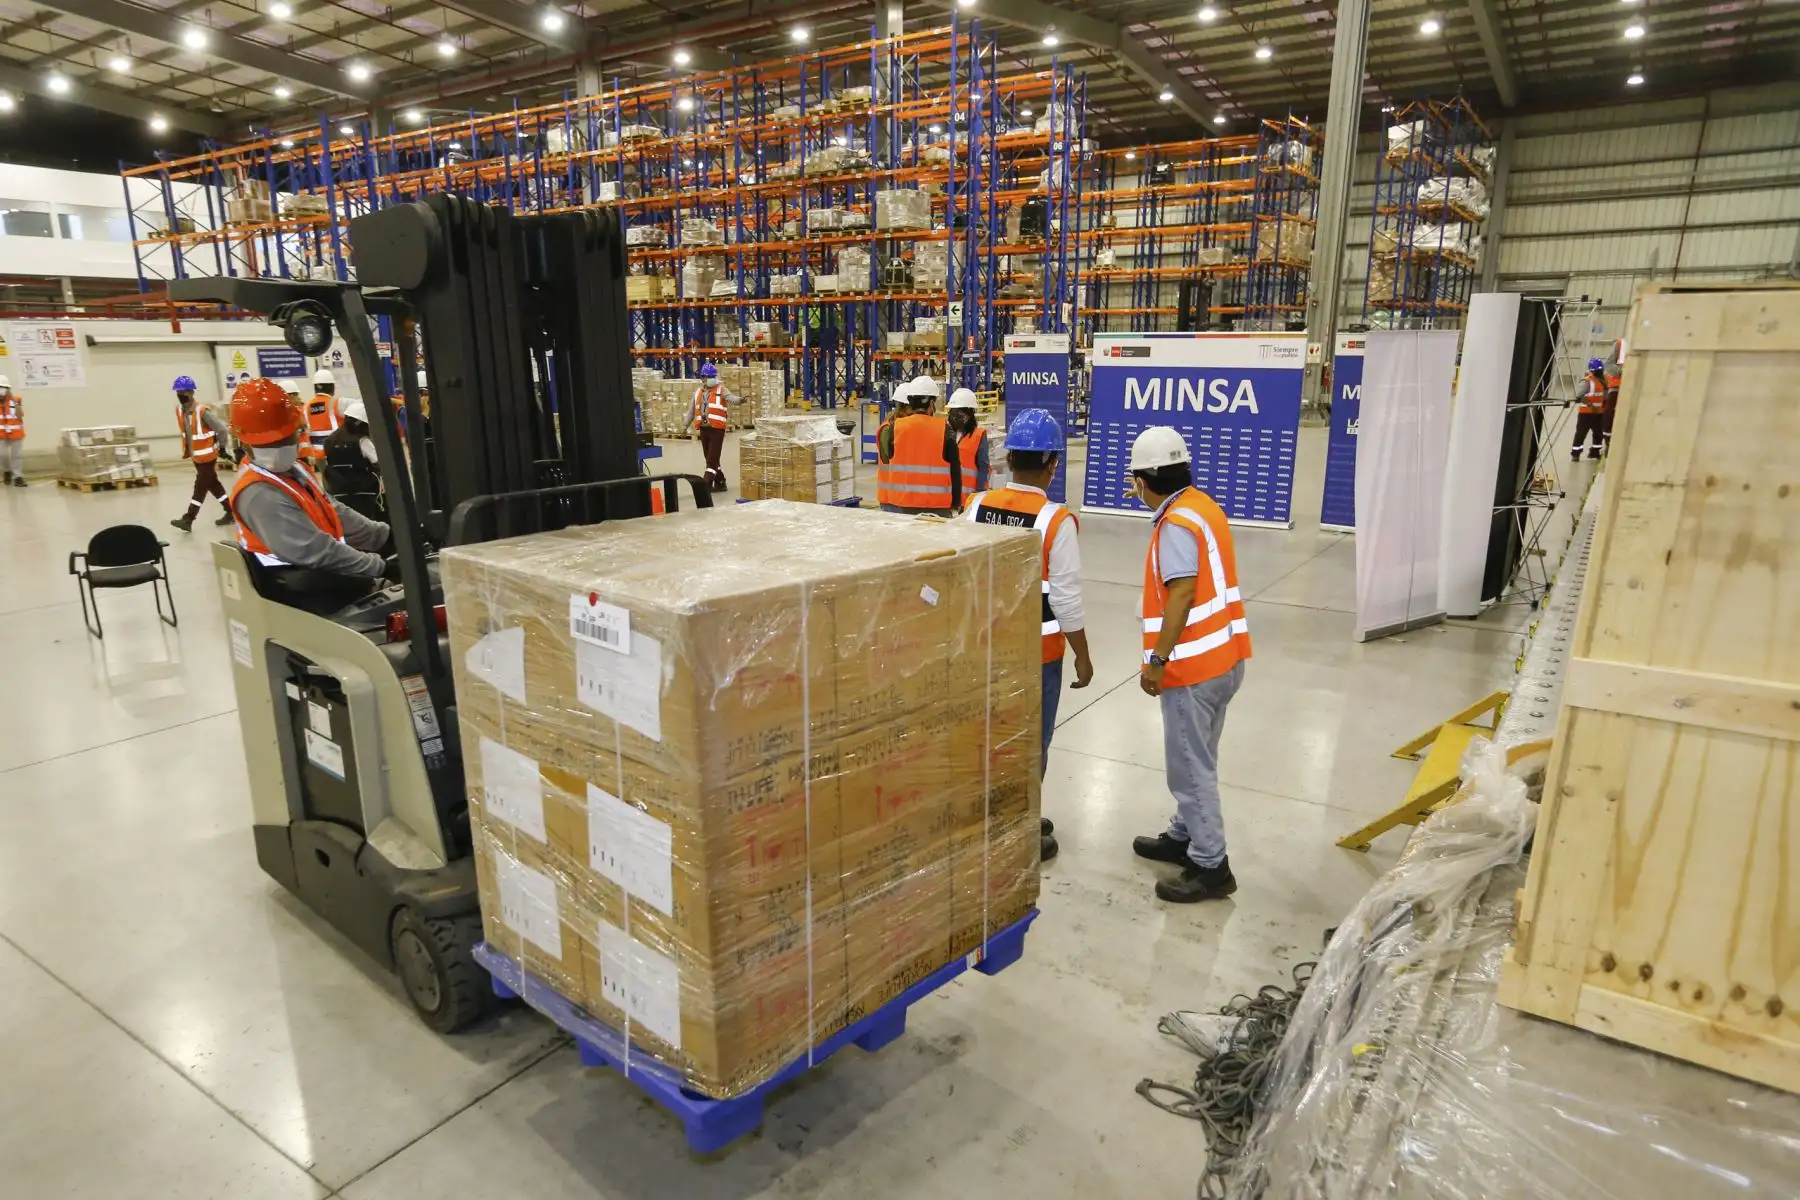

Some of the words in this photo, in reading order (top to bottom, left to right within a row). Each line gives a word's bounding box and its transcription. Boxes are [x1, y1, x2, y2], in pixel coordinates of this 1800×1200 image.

[954, 112, 965, 122] 04
[995, 124, 1006, 133] 05
[1053, 142, 1063, 150] 06
[1083, 152, 1093, 161] 07
[1012, 372, 1059, 386] MINSA
[1124, 377, 1259, 415] MINSA
